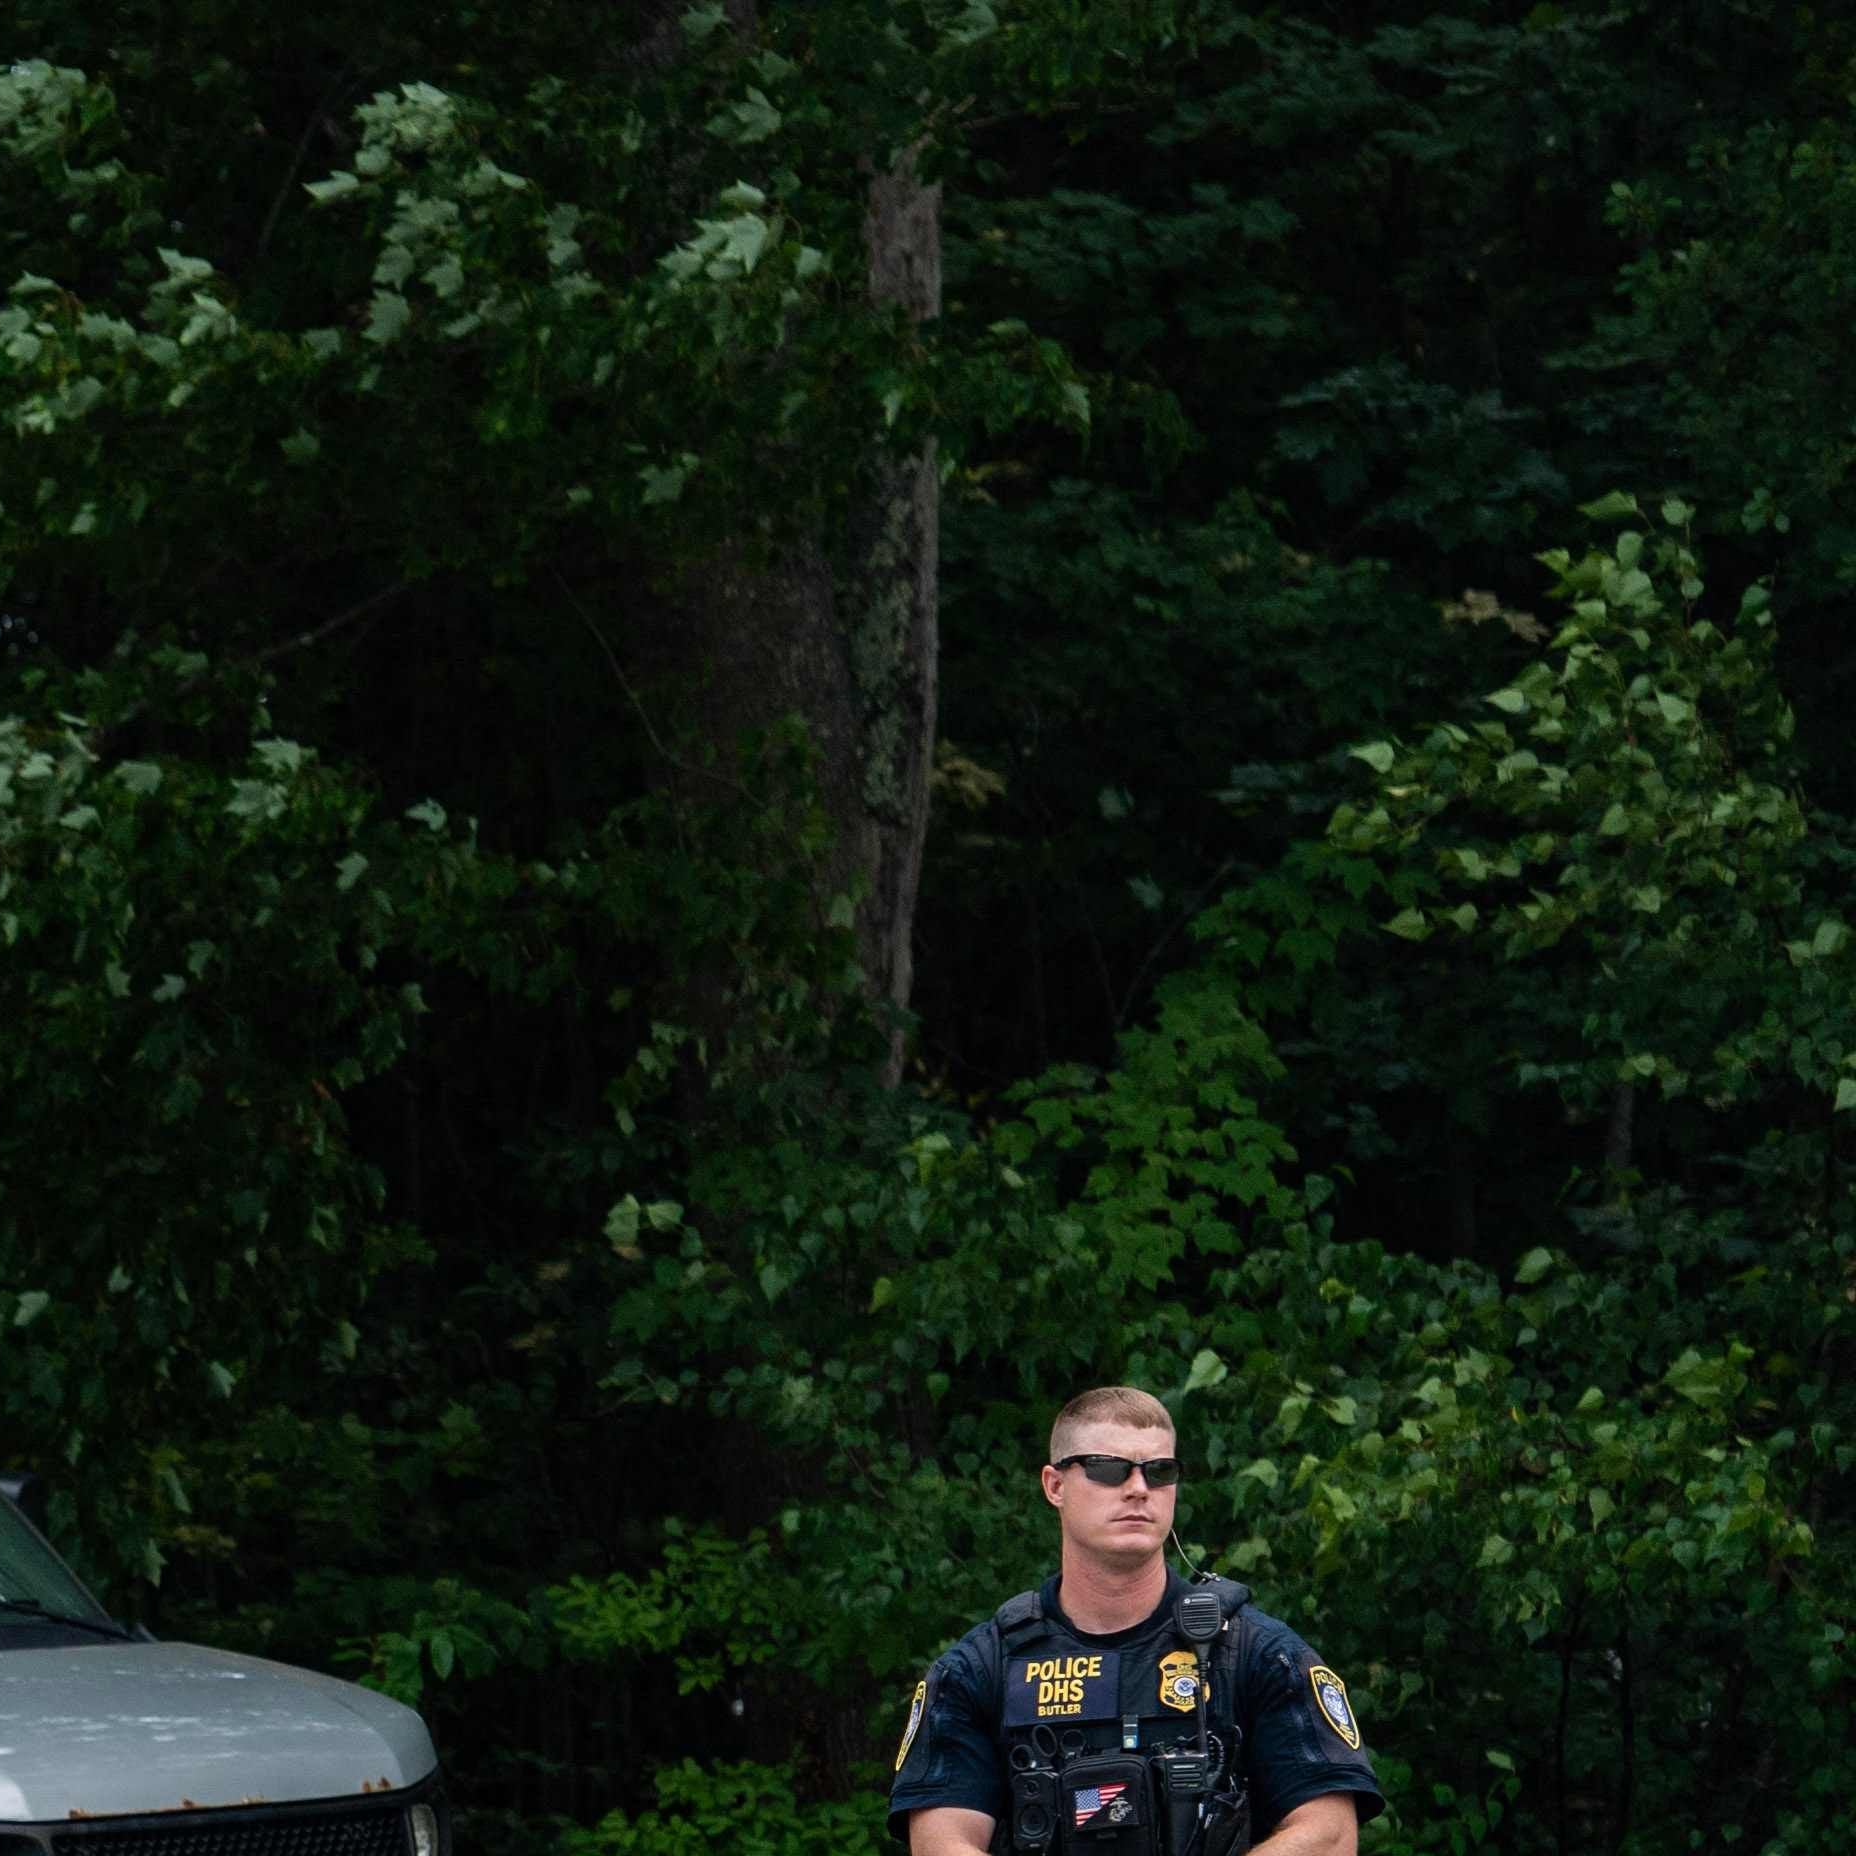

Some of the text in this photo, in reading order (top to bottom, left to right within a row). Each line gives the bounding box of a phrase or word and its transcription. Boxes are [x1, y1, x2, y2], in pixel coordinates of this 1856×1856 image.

[1025, 1656, 1103, 1682] POLICE
[1038, 1679, 1084, 1704] DHS
[1038, 1703, 1082, 1717] BUTLER
